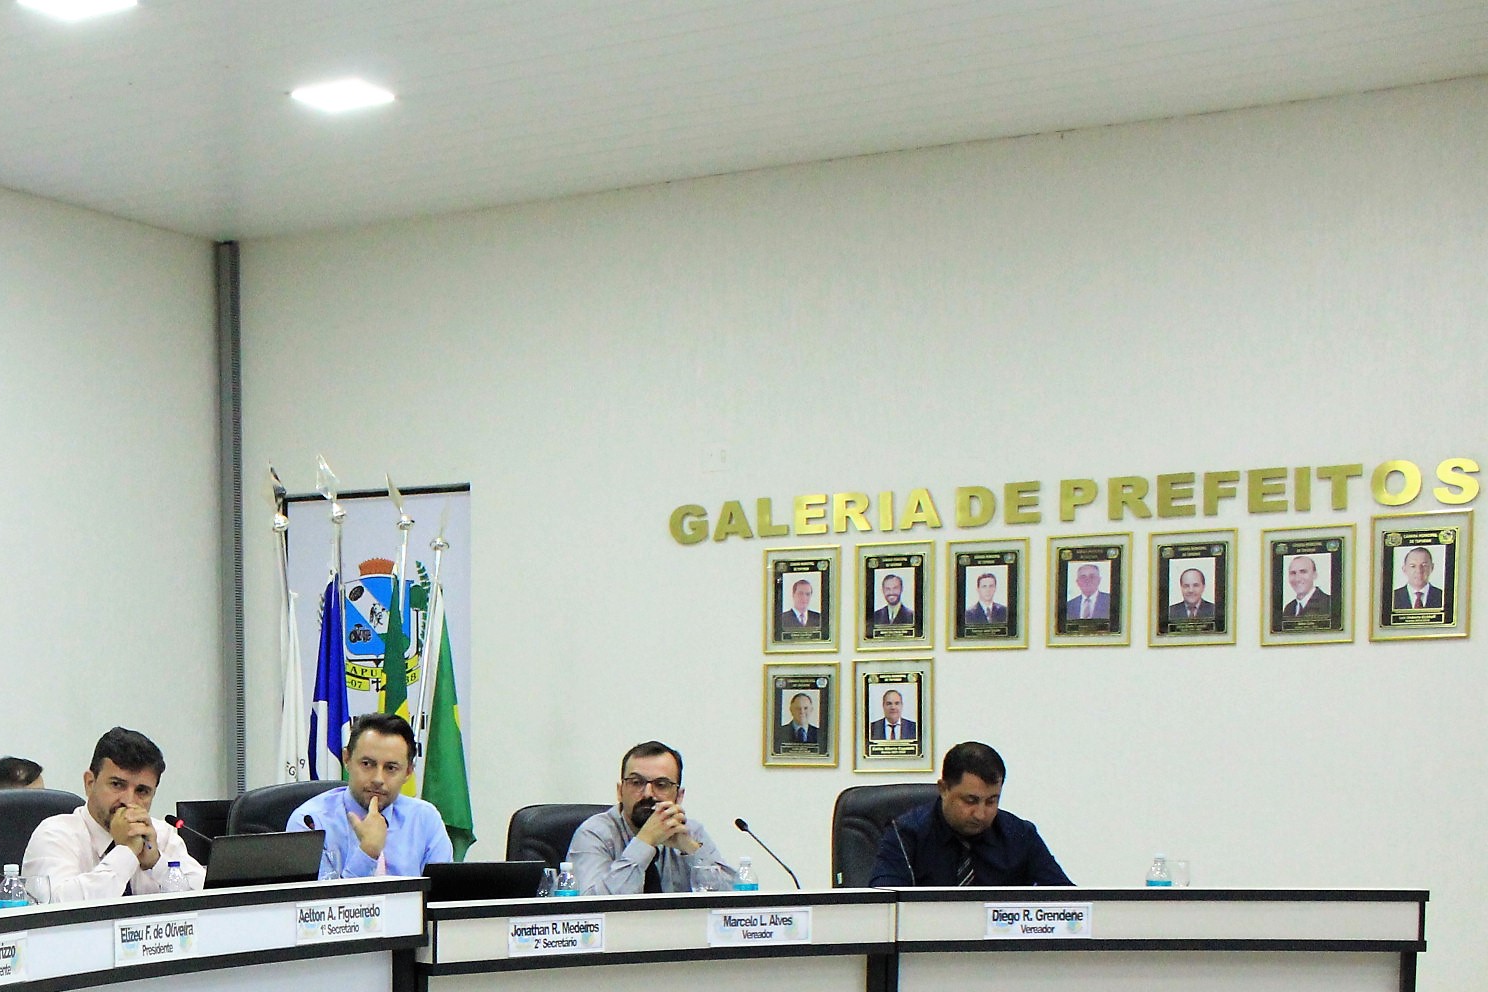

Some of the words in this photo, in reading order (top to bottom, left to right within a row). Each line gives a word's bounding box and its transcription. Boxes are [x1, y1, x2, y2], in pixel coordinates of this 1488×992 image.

[668, 488, 943, 545] GALERIA
[955, 480, 1042, 528] DE
[1059, 457, 1480, 522] PREFEITOS
[298, 908, 325, 924] Aelton
[327, 906, 336, 921] A.
[338, 903, 381, 923] Figueiredo
[723, 915, 758, 928] Marcelo
[759, 914, 767, 926] L.
[768, 913, 794, 927] Alves
[992, 909, 1020, 925] Diego
[1023, 909, 1033, 921] R.
[1035, 908, 1084, 921] Grendene
[120, 927, 143, 943] Elizeu
[145, 925, 153, 940] F.
[153, 924, 163, 939] de
[165, 921, 194, 938] Oliveira
[511, 921, 550, 937] Jonathan
[551, 921, 561, 935] R.
[562, 919, 599, 934] Medeiros
[742, 928, 773, 941] Vereador
[1020, 924, 1055, 935] Vereador
[142, 943, 174, 956] Presidente
